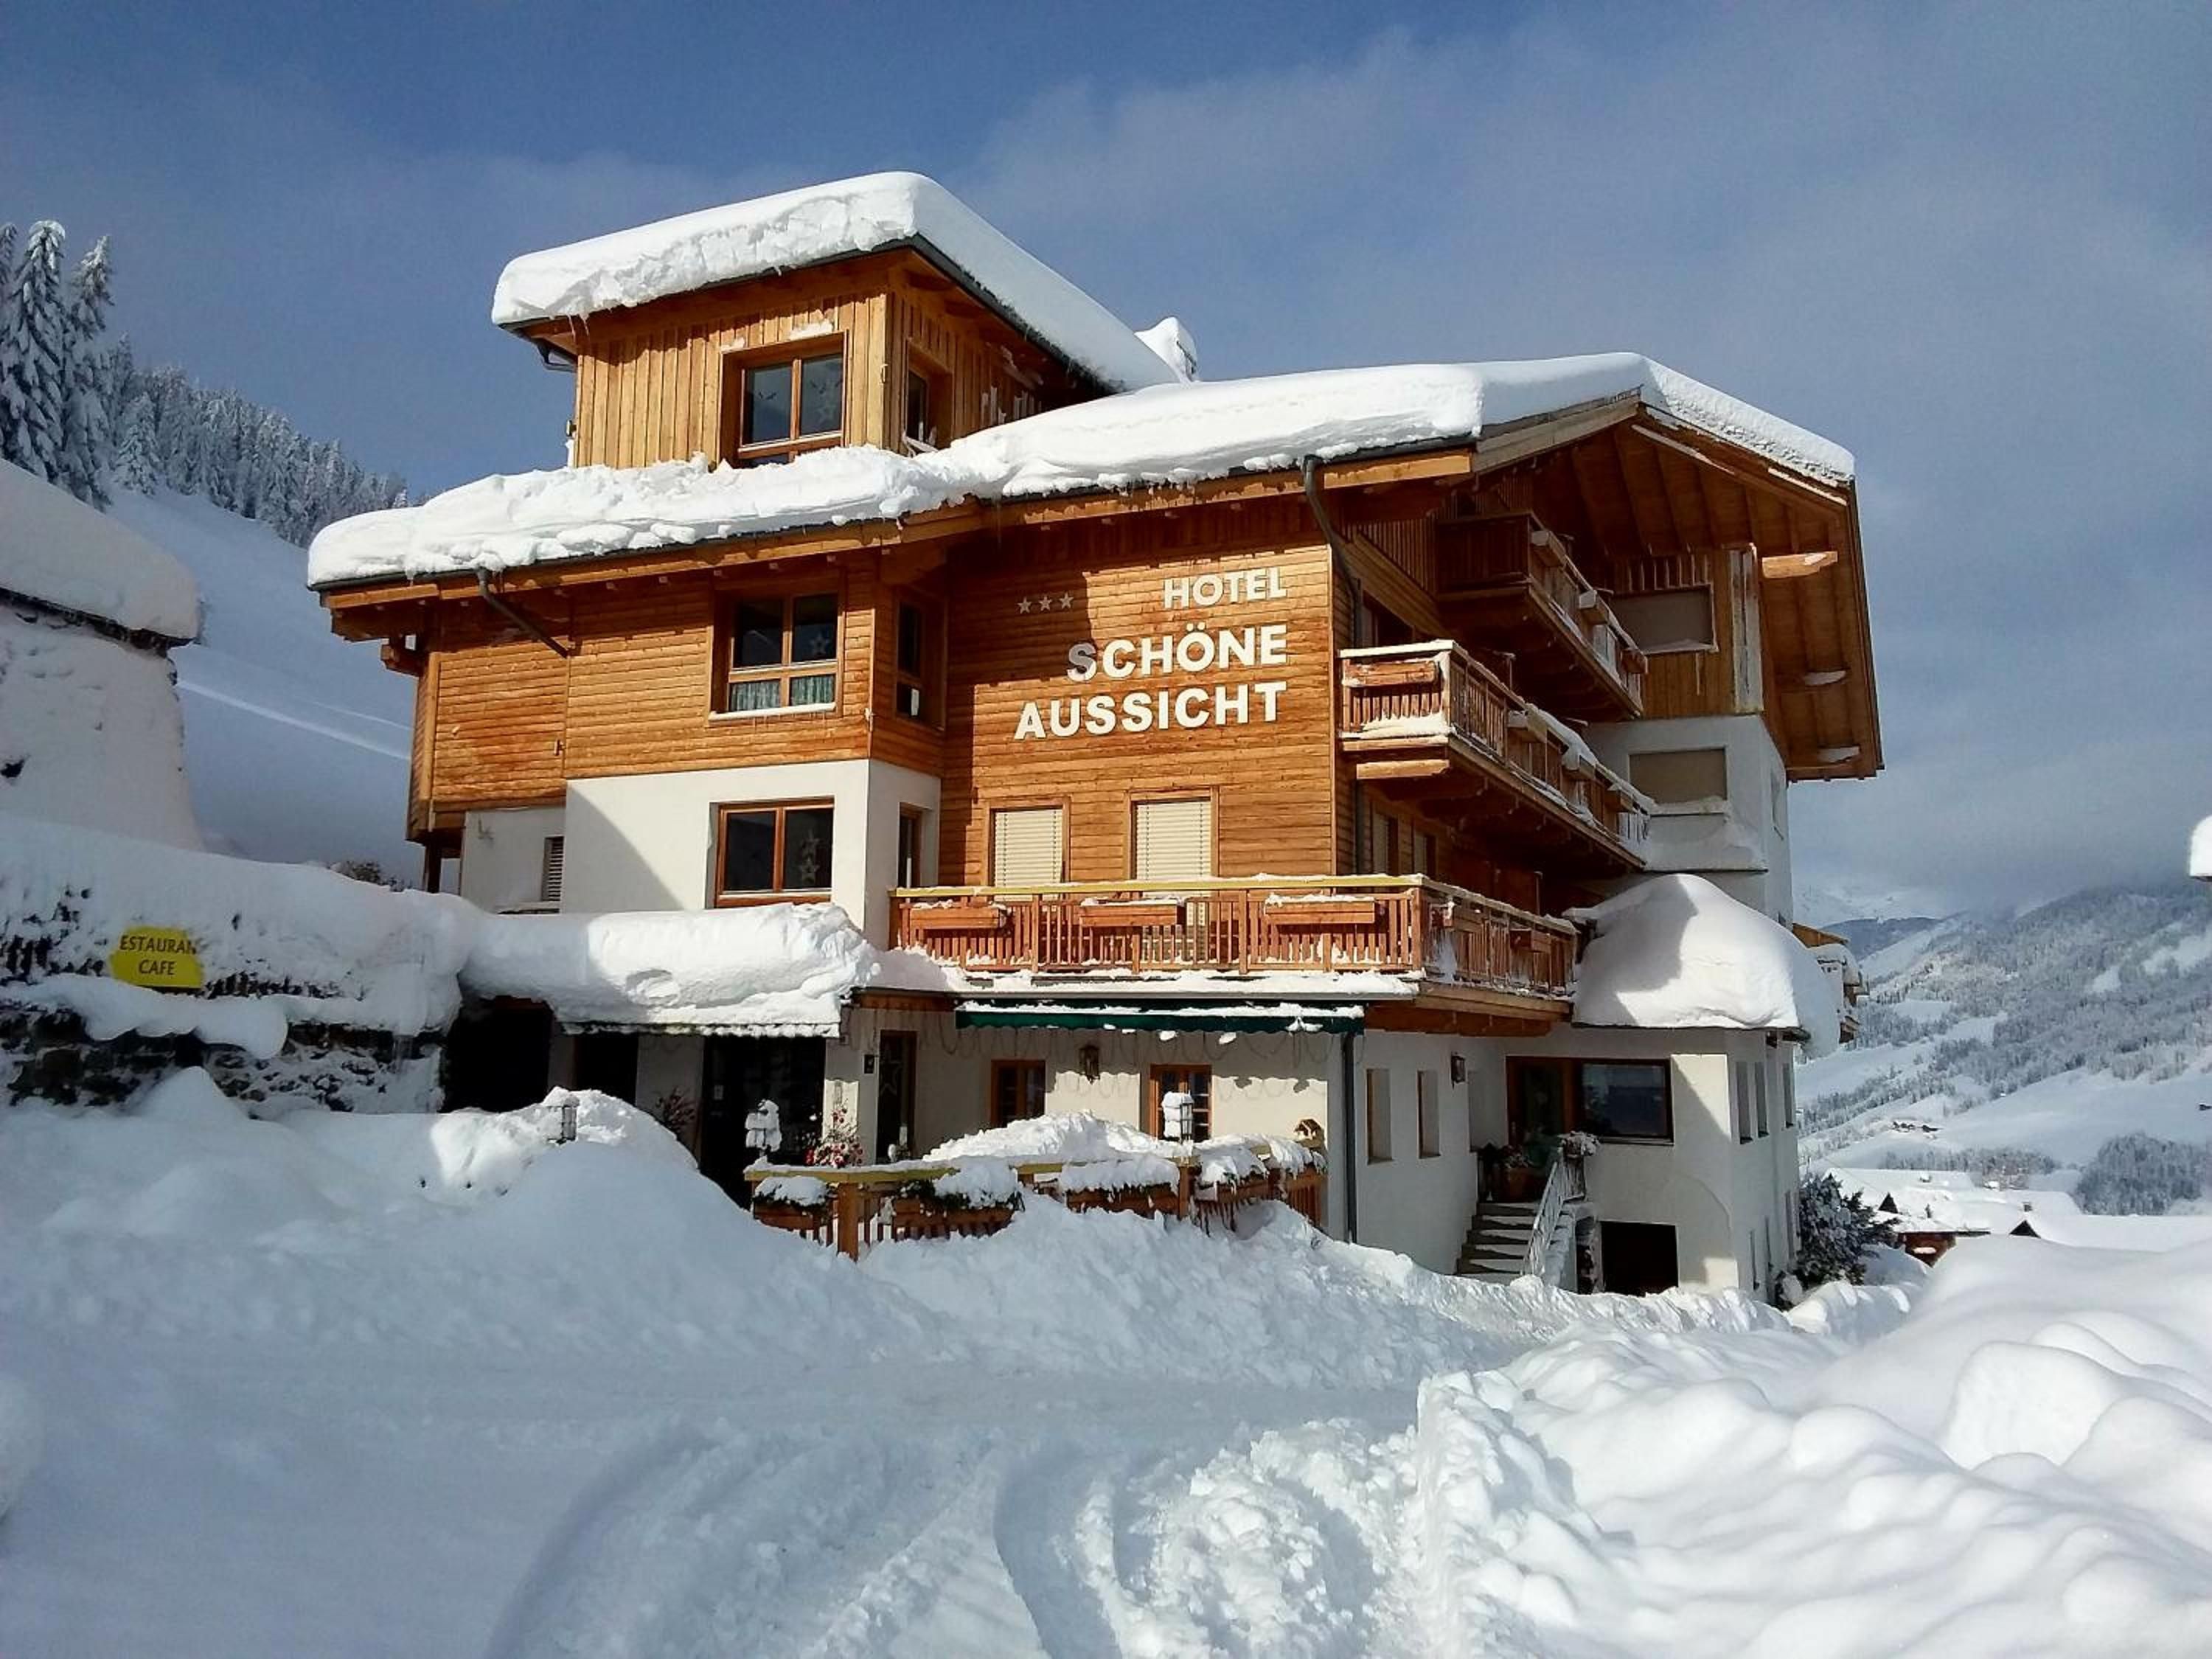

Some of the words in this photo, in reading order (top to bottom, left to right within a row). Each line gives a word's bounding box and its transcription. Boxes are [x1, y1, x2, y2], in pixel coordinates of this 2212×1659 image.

[1164, 566, 1287, 610] HOTEL
[1066, 622, 1287, 682] SCHÖNE
[1014, 681, 1287, 740] AUSSICHT
[139, 959, 176, 975] CAFE
